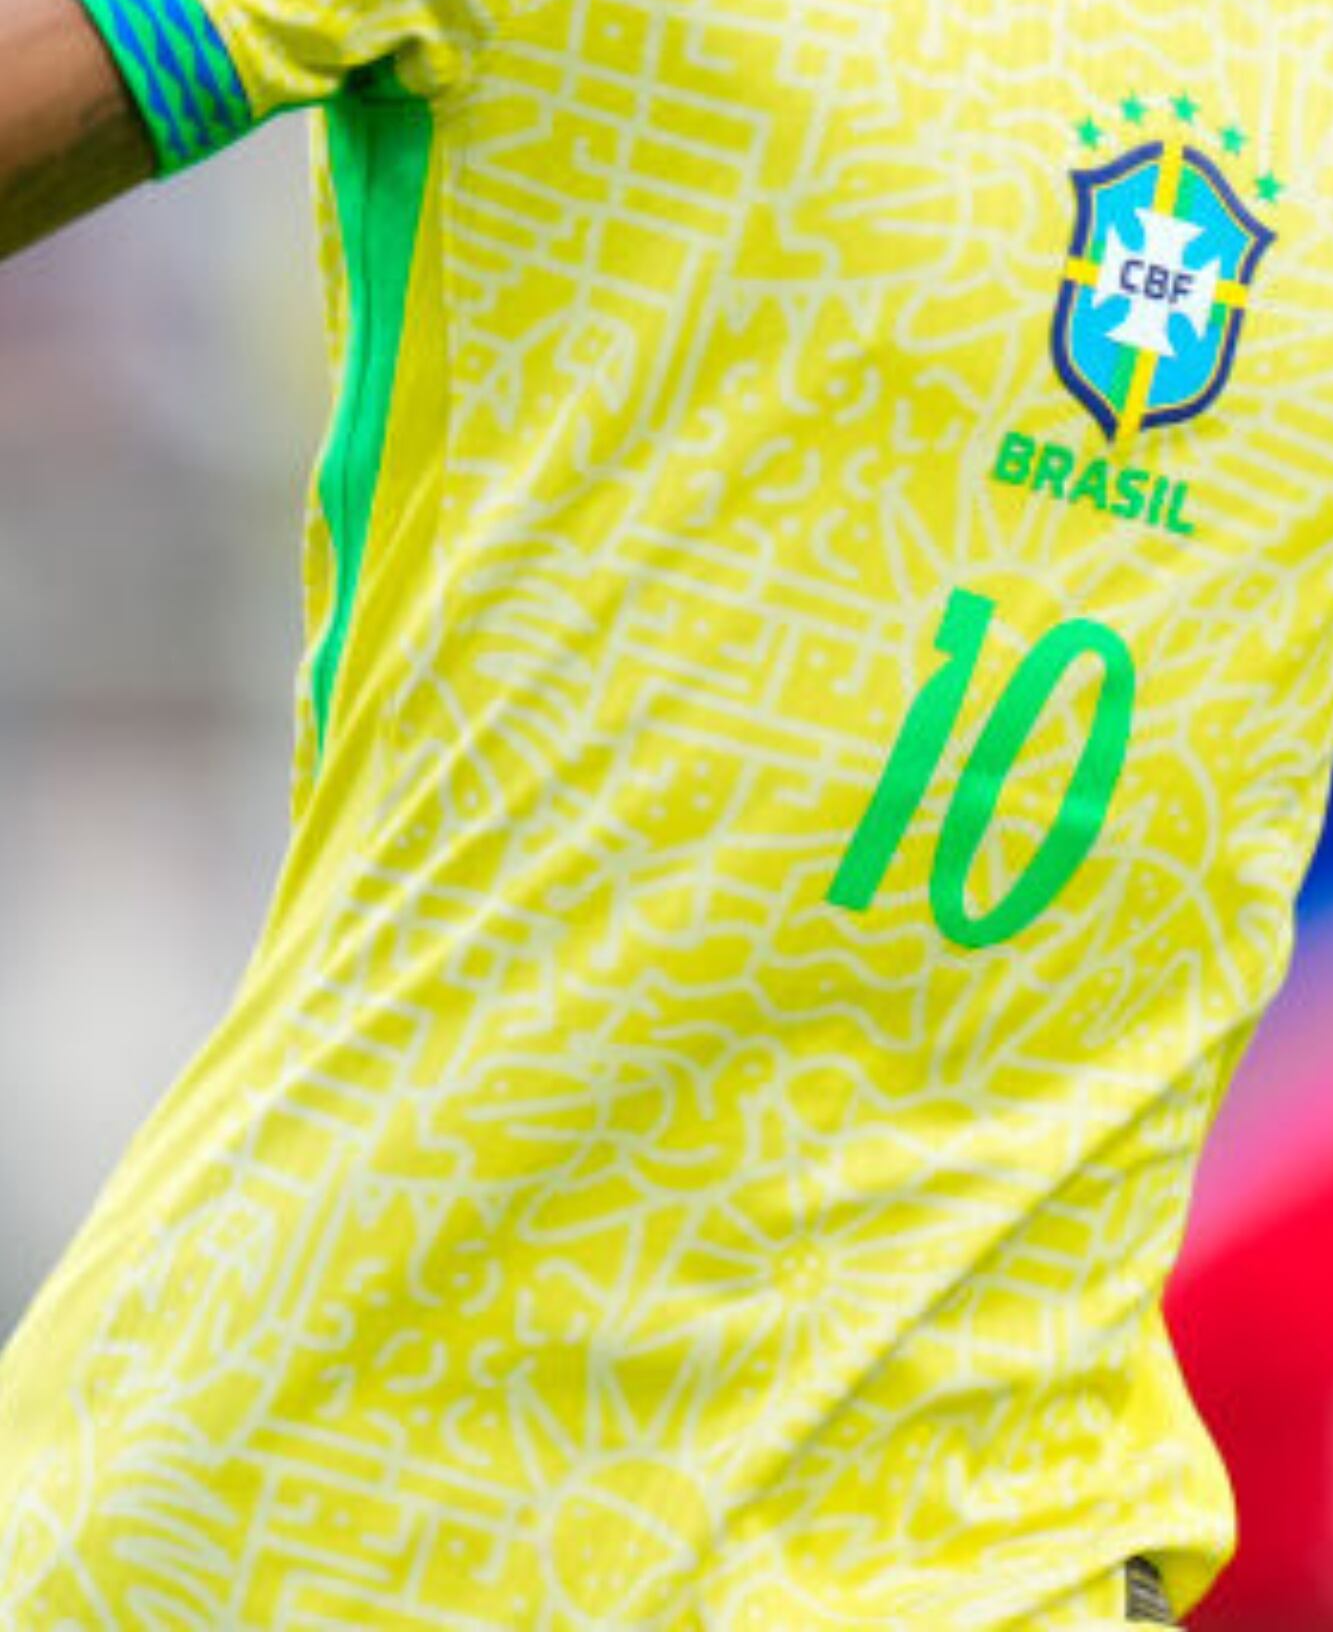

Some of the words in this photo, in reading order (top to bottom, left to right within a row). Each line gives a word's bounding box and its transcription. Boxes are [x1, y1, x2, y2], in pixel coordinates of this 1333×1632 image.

[1119, 258, 1194, 305] CBF
[992, 431, 1195, 535] BRASIL
[825, 586, 1136, 950] 10
